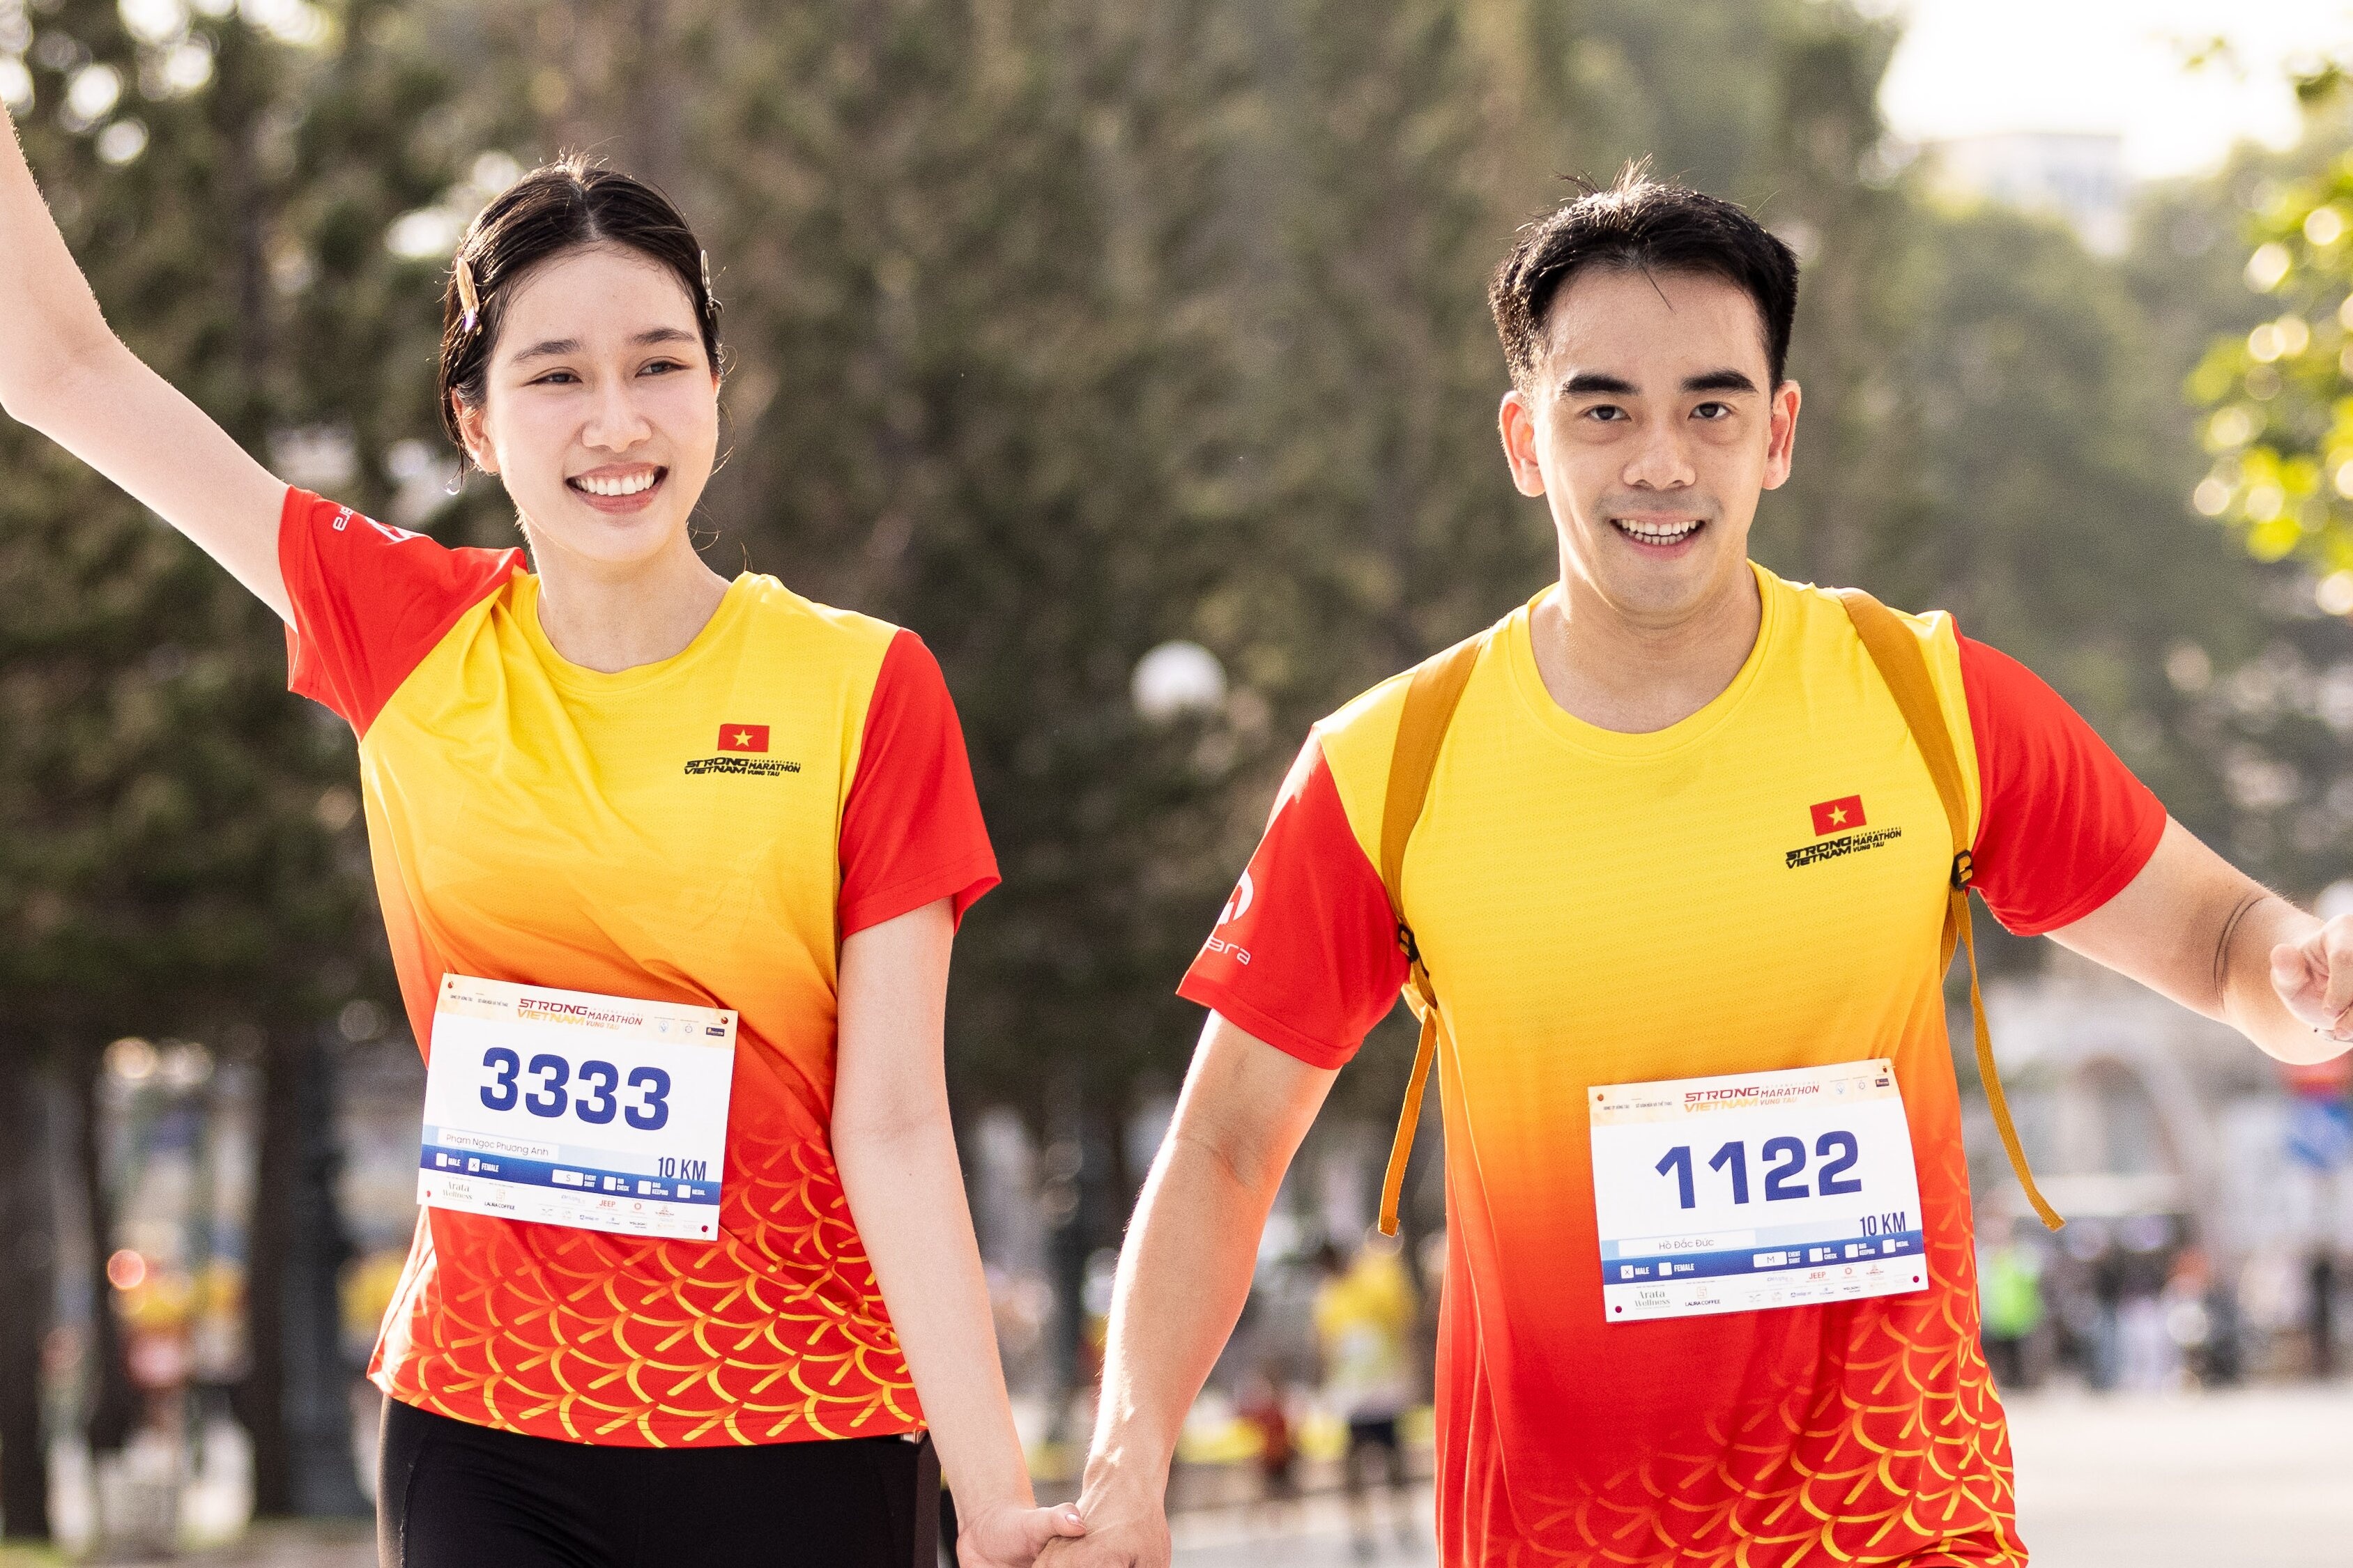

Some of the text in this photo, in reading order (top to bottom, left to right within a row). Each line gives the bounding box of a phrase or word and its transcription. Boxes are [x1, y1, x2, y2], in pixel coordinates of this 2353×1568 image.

[687, 757, 749, 768] STRONG
[749, 762, 801, 774] MARATHON
[684, 766, 746, 774] VIETNAM
[1853, 827, 1901, 838] INTERNATIONAL
[1853, 830, 1901, 847] MARATHON
[1786, 836, 1851, 861] STRONG
[1853, 844, 1871, 853] VUNG
[1786, 845, 1851, 869] VIETNAM
[519, 999, 588, 1015] STRONG
[517, 1008, 585, 1026] VIETNAM
[588, 1011, 643, 1026] MARATHON
[480, 1047, 670, 1130] 3333
[1685, 1086, 1760, 1102] STRONG
[1761, 1085, 1819, 1098] MARATHON
[1684, 1097, 1758, 1113] VIETNAM
[531, 1147, 549, 1156] Anh
[448, 1158, 461, 1167] MALE
[482, 1162, 499, 1172] FEMALE
[658, 1157, 707, 1181] 10 KM
[1655, 1130, 1862, 1209] 1122
[1860, 1211, 1906, 1237] 10 KM
[1634, 1266, 1650, 1275] MALE
[1673, 1263, 1694, 1273] FEMALE
[1809, 1272, 1826, 1280] JEEP
[1640, 1290, 1665, 1299] Arata
[1634, 1298, 1671, 1307] Wellness
